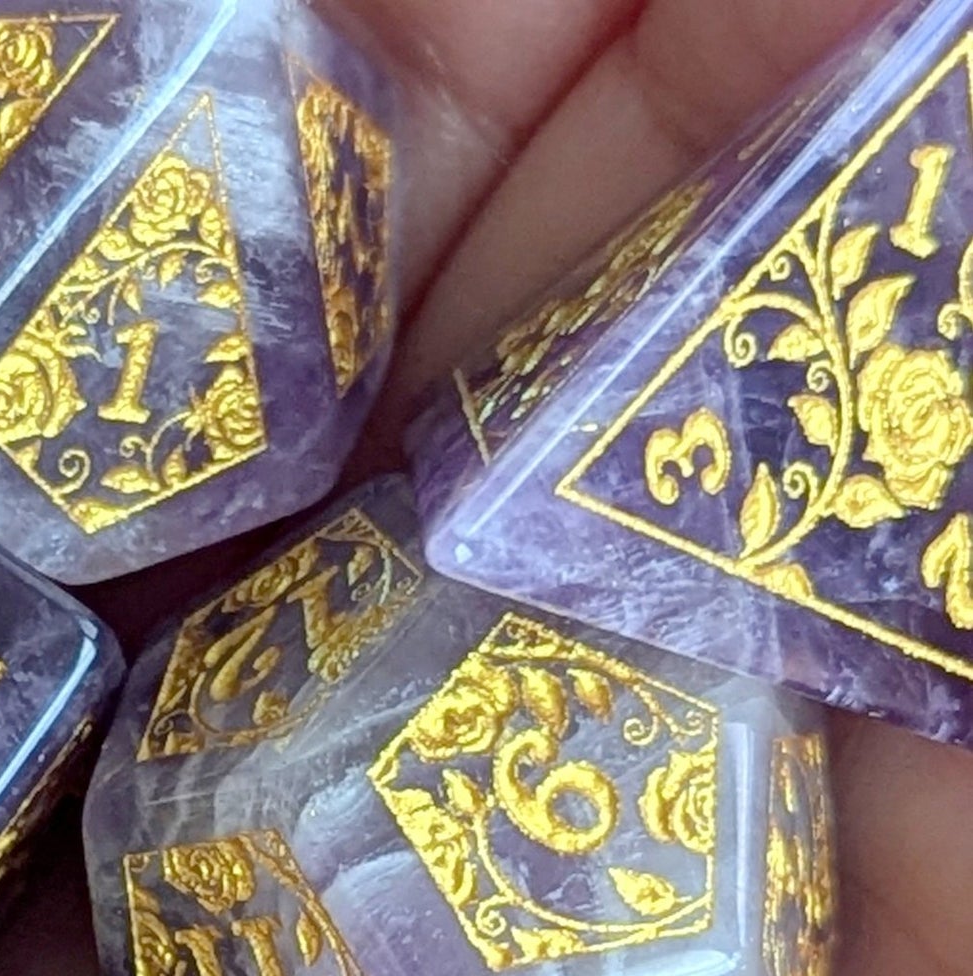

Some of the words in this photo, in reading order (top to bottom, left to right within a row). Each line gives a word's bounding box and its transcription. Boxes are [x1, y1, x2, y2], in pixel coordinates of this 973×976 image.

[890, 143, 953, 258] 1
[97, 320, 161, 423] 1
[646, 407, 733, 504] 3
